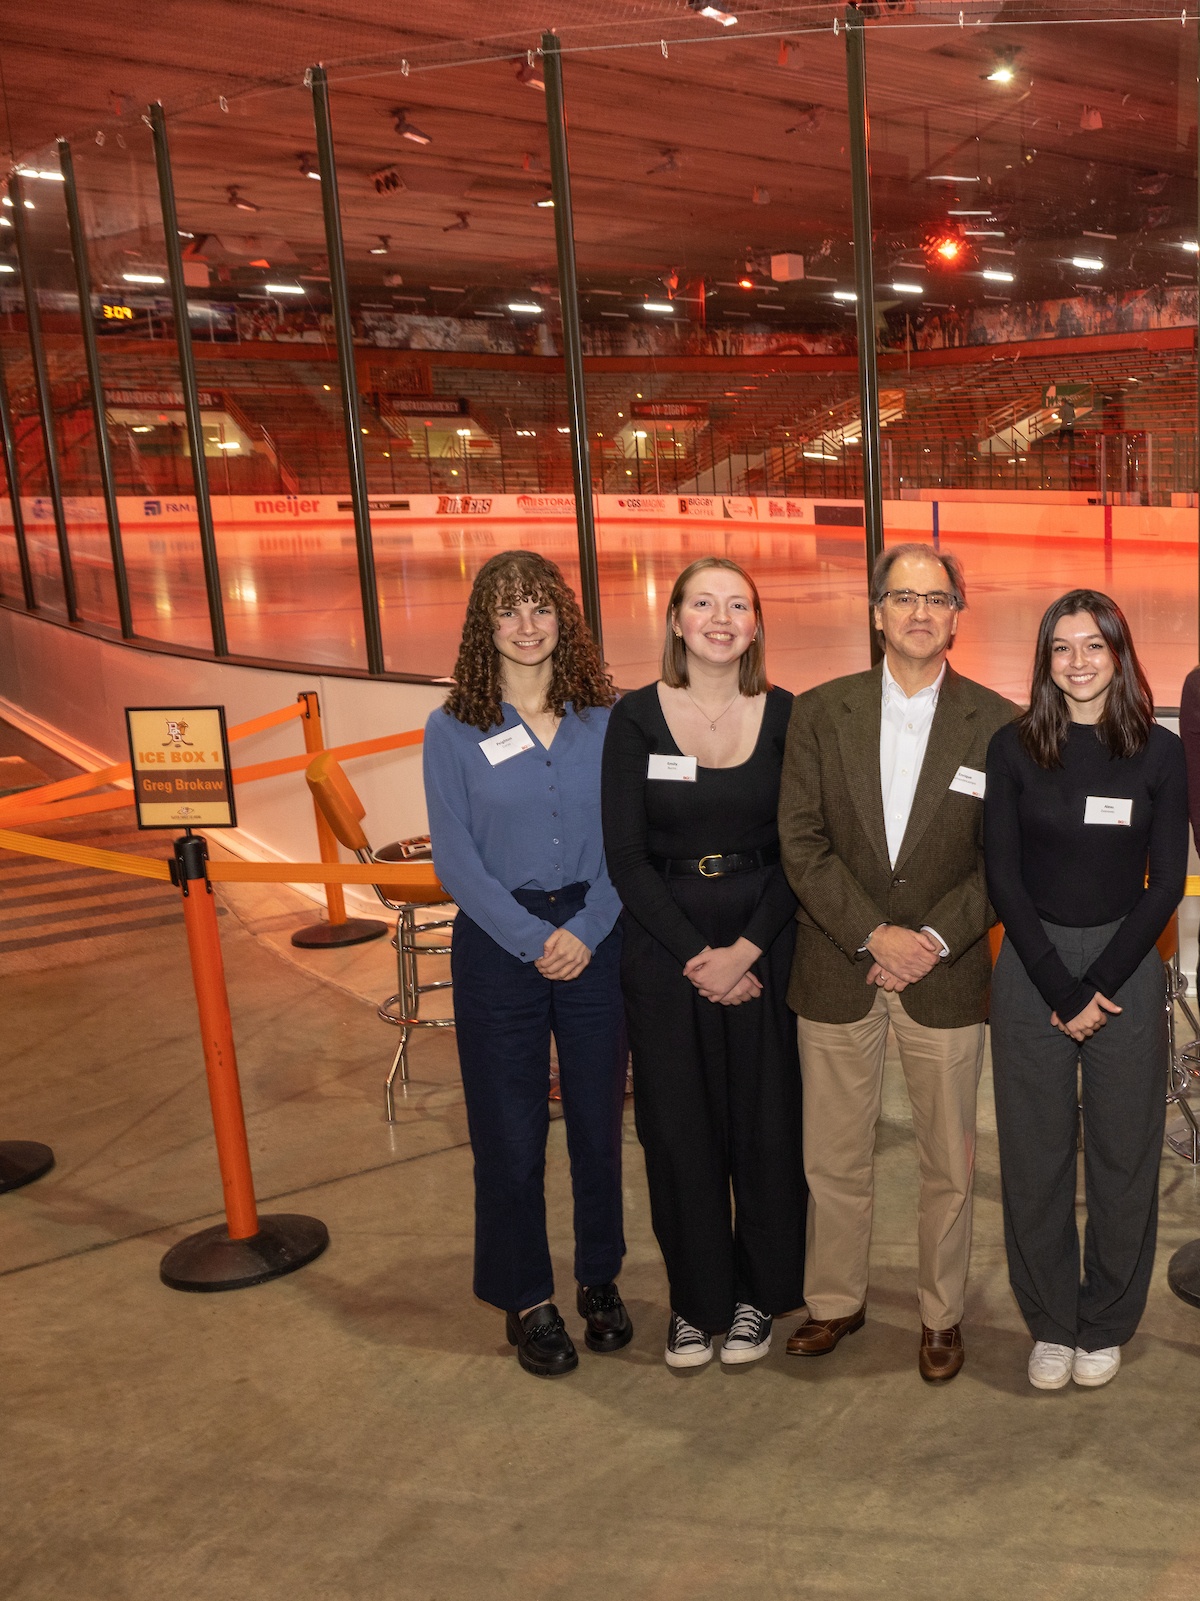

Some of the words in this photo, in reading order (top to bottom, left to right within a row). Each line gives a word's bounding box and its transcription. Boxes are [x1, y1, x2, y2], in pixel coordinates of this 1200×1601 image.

[254, 495, 320, 517] meijer
[138, 751, 166, 764] ICE
[170, 751, 206, 763] BOX
[210, 751, 220, 762] 1
[142, 778, 173, 793] Greg
[175, 778, 224, 791] Brokaw
